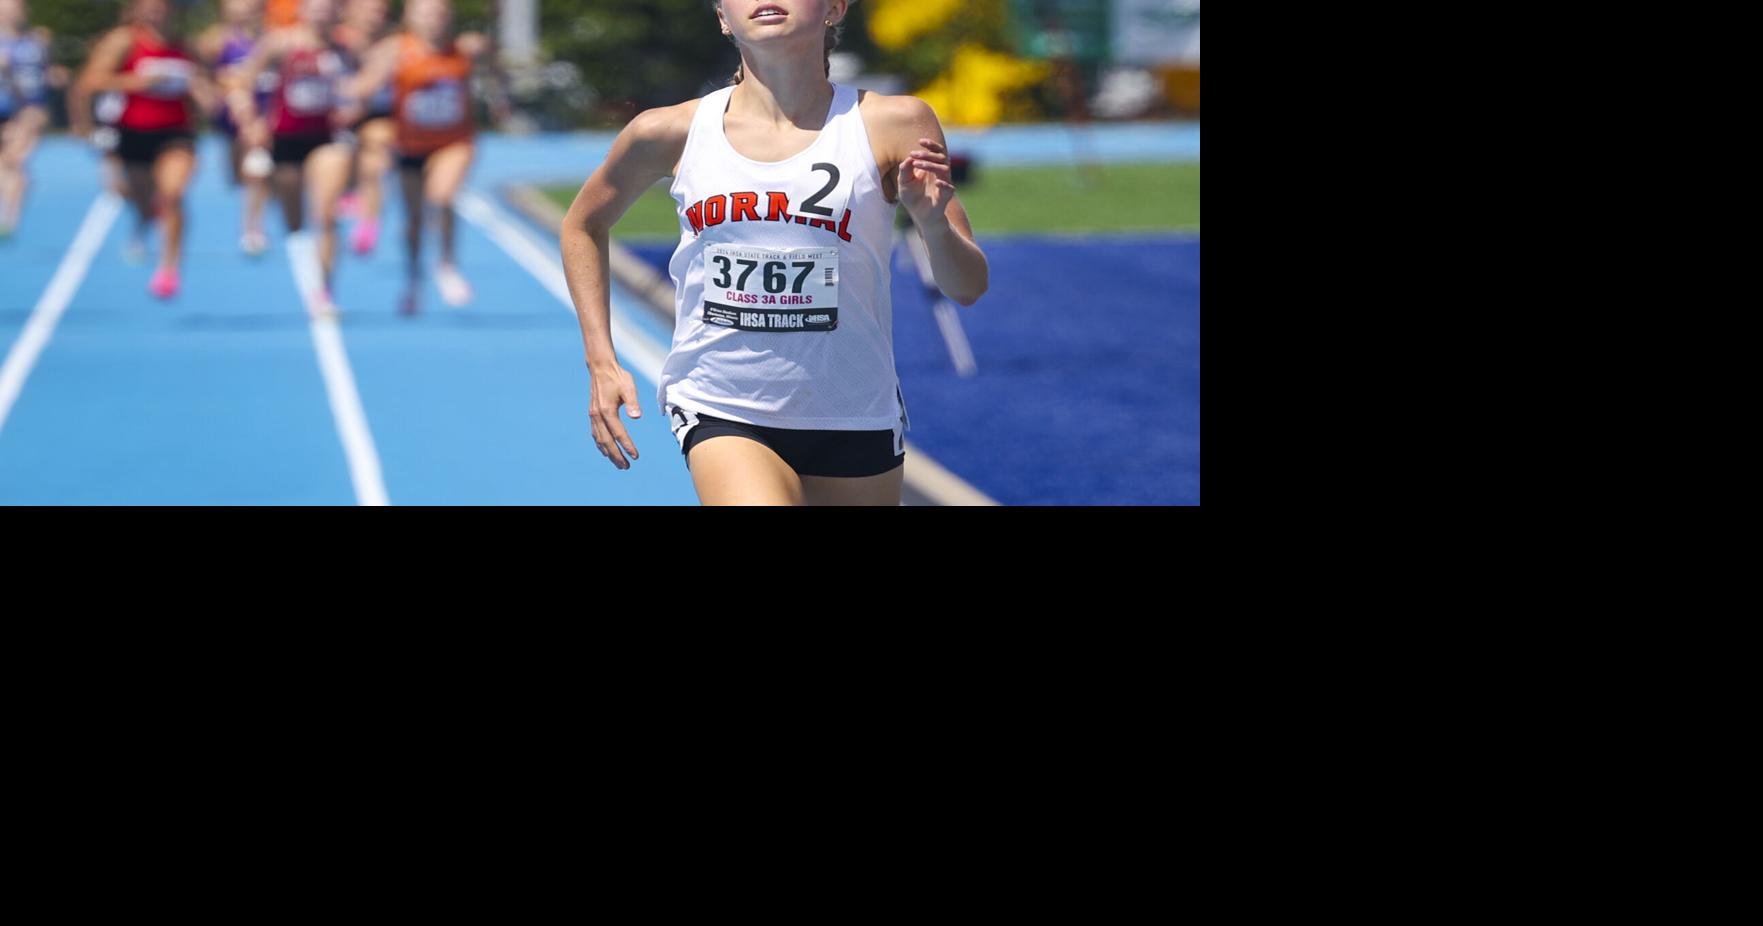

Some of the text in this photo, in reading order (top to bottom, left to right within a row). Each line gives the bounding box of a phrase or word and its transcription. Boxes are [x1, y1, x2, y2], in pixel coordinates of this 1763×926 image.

[799, 162, 841, 217] 2
[712, 255, 815, 294] 3767
[726, 291, 813, 305] CLASS 3A GIRLS
[739, 311, 767, 328] IHSA
[767, 312, 805, 328] TRACK
